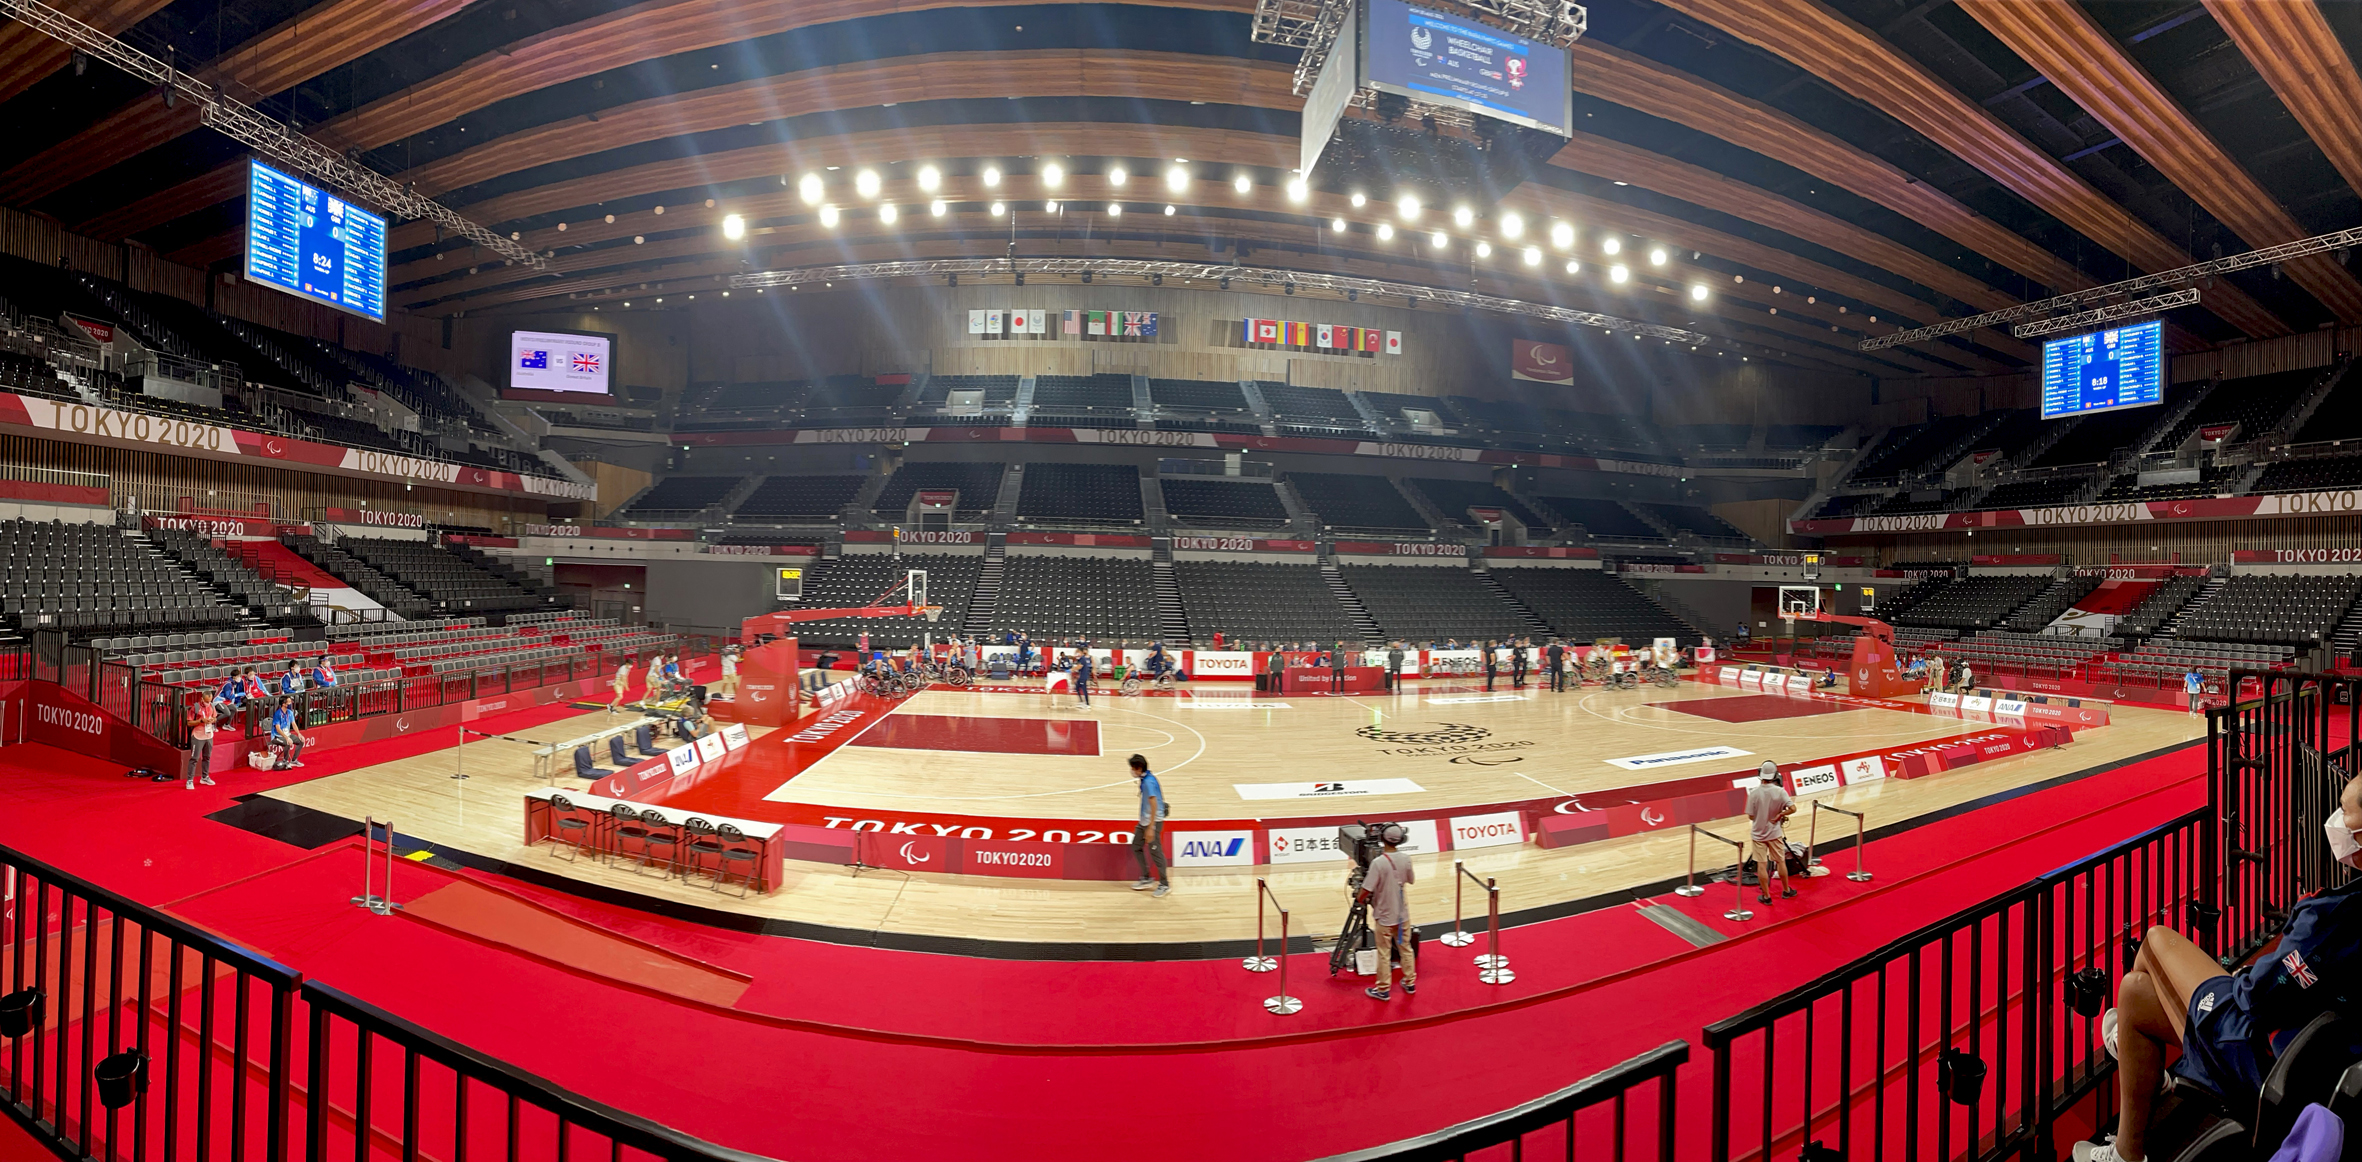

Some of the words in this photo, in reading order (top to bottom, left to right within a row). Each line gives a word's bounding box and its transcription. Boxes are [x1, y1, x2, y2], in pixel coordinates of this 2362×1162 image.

[1447, 36, 1493, 55] WHEELCHAIR
[1448, 46, 1492, 64] BASKETBALL
[305, 204, 316, 213] AUS
[307, 216, 314, 228] 0
[332, 226, 339, 238] 0
[312, 252, 332, 269] 8:24
[93, 328, 109, 337] 2020
[2087, 355, 2092, 364] 0
[2108, 351, 2114, 360] 0
[50, 401, 150, 441] TOKYO
[158, 418, 220, 451] 2020
[816, 429, 865, 442] TOKYO
[871, 429, 907, 442] 2020
[1097, 429, 1150, 444] TOKYO
[1155, 431, 1194, 446] 2020
[1377, 443, 1425, 459] TOKYO
[1428, 447, 1462, 461] 2020
[356, 450, 410, 477] TOKYO
[414, 460, 450, 482] 2020
[1614, 461, 1653, 475] TOKYO
[1655, 465, 1684, 478] 2020
[528, 476, 564, 496] TOKYO
[567, 483, 592, 499] 2020
[2274, 490, 2356, 514] TOKYO
[359, 509, 396, 526] TOKYO
[397, 513, 423, 528] 2020
[2033, 505, 2088, 526] TOKYO
[2092, 502, 2138, 523] 2020
[211, 521, 244, 536] 2020
[1861, 516, 1902, 531] TOKYO
[1905, 515, 1937, 530] 2020
[550, 525, 581, 537] 2020
[900, 531, 937, 543] OKYO
[938, 531, 971, 543] 2020
[708, 544, 743, 555] TOKYO
[743, 545, 771, 556] 2020
[1173, 536, 1217, 549] TOKYO
[1219, 538, 1253, 551] 2020
[1394, 543, 1435, 555] TOKYO
[1436, 544, 1466, 556] 2020
[1762, 554, 1798, 565] TOKYO
[2275, 549, 2327, 563] TOKYO
[2331, 548, 2361, 562] 202
[1903, 569, 1928, 579] TOKYO
[2109, 568, 2135, 579] 2020
[1198, 659, 1248, 669] TOYOTA
[2032, 682, 2048, 690] TOKYO
[1998, 703, 2015, 712] ANA
[2032, 707, 2048, 715] TOKYO
[2049, 709, 2061, 717] 2020
[37, 703, 72, 728] TOKYO
[74, 710, 103, 736] 2020
[782, 722, 844, 744] TOKYO
[1376, 744, 1467, 756] TOKYO
[1472, 740, 1535, 750] 2020
[1984, 745, 2000, 754] TOKYO
[2000, 742, 2011, 752] 2020
[1629, 747, 1729, 765] Panasonic
[1803, 771, 1835, 787] ENEOS
[822, 816, 995, 840] TOKYO
[1007, 829, 1137, 845] 2020
[1457, 822, 1517, 840] TOYOTA
[1180, 840, 1223, 858] ANA
